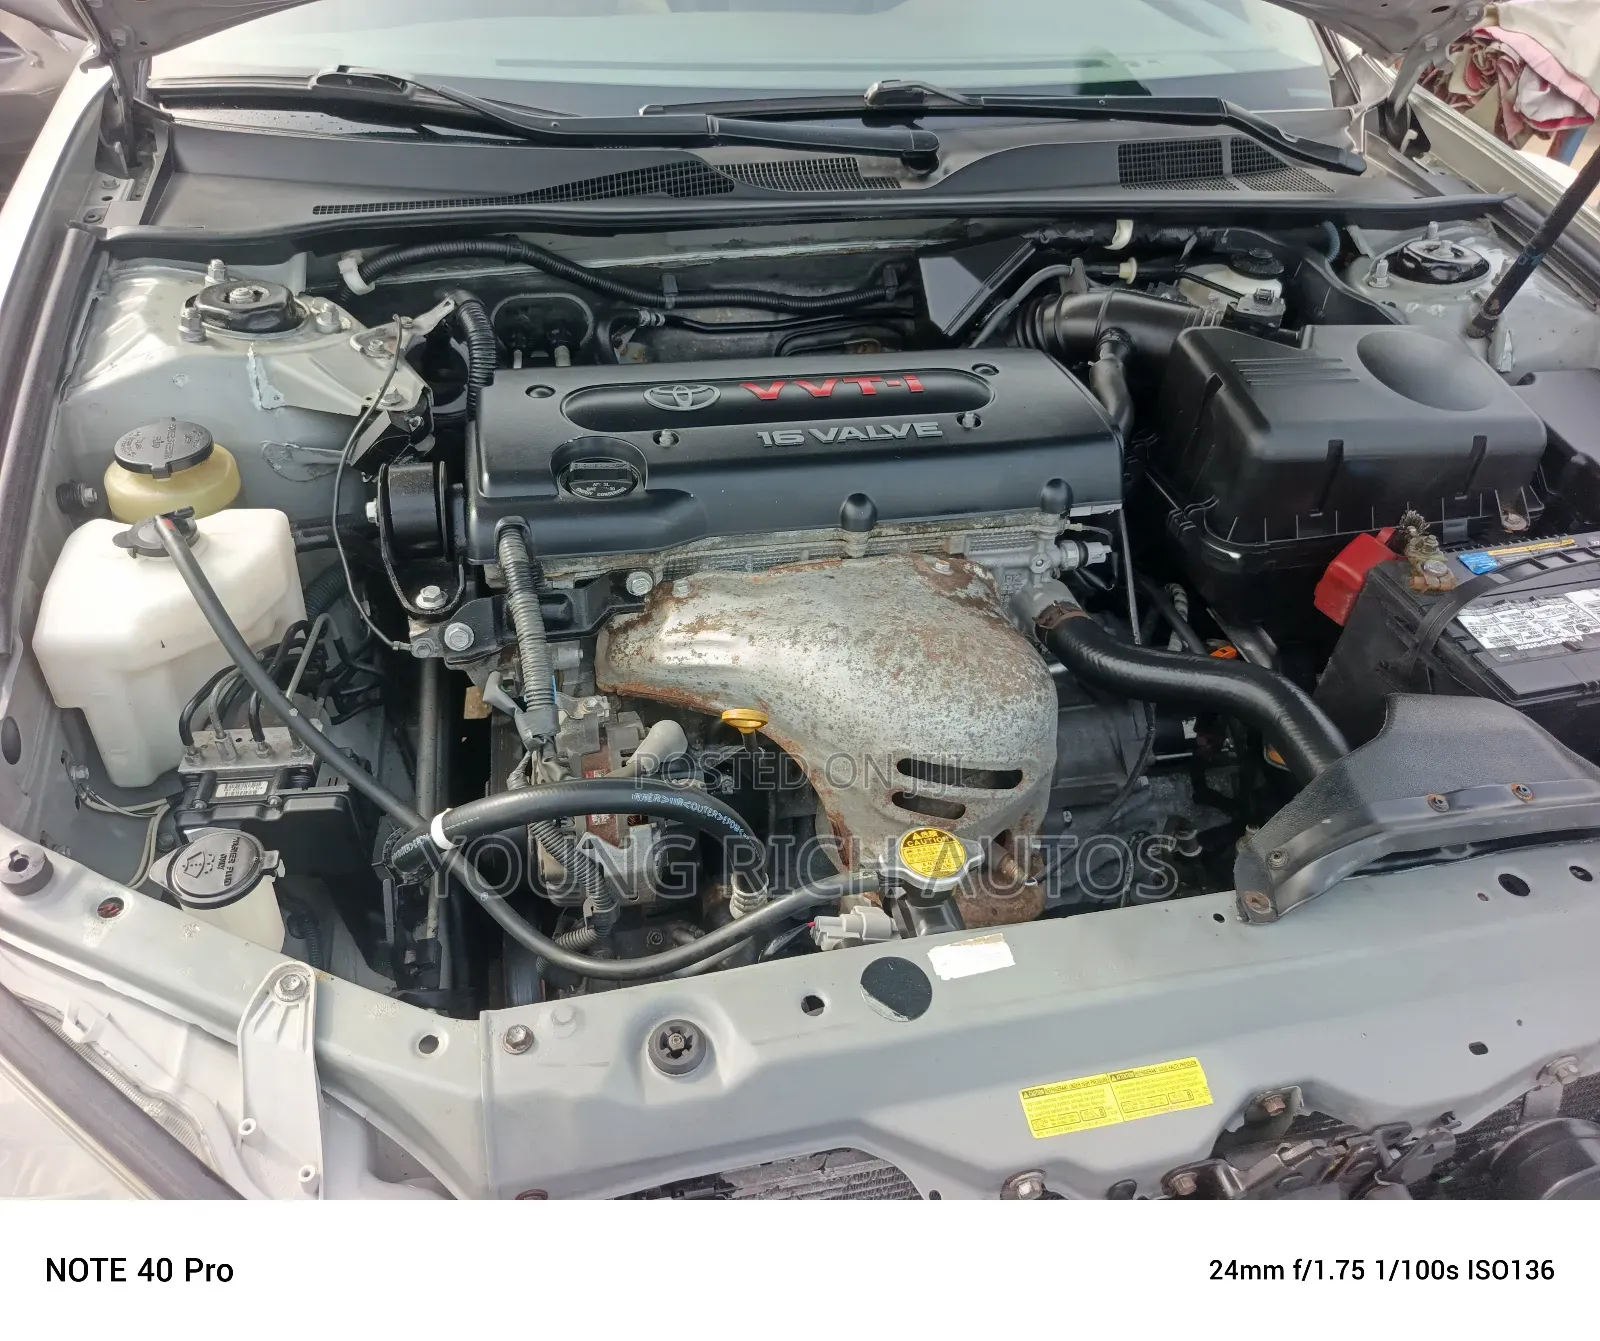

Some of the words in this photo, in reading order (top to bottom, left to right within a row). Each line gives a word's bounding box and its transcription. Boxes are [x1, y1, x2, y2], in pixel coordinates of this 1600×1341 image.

[756, 429, 805, 447] 16
[807, 421, 944, 445] VALVE
[907, 836, 949, 847] CAUTION
[223, 866, 235, 887] FLUID
